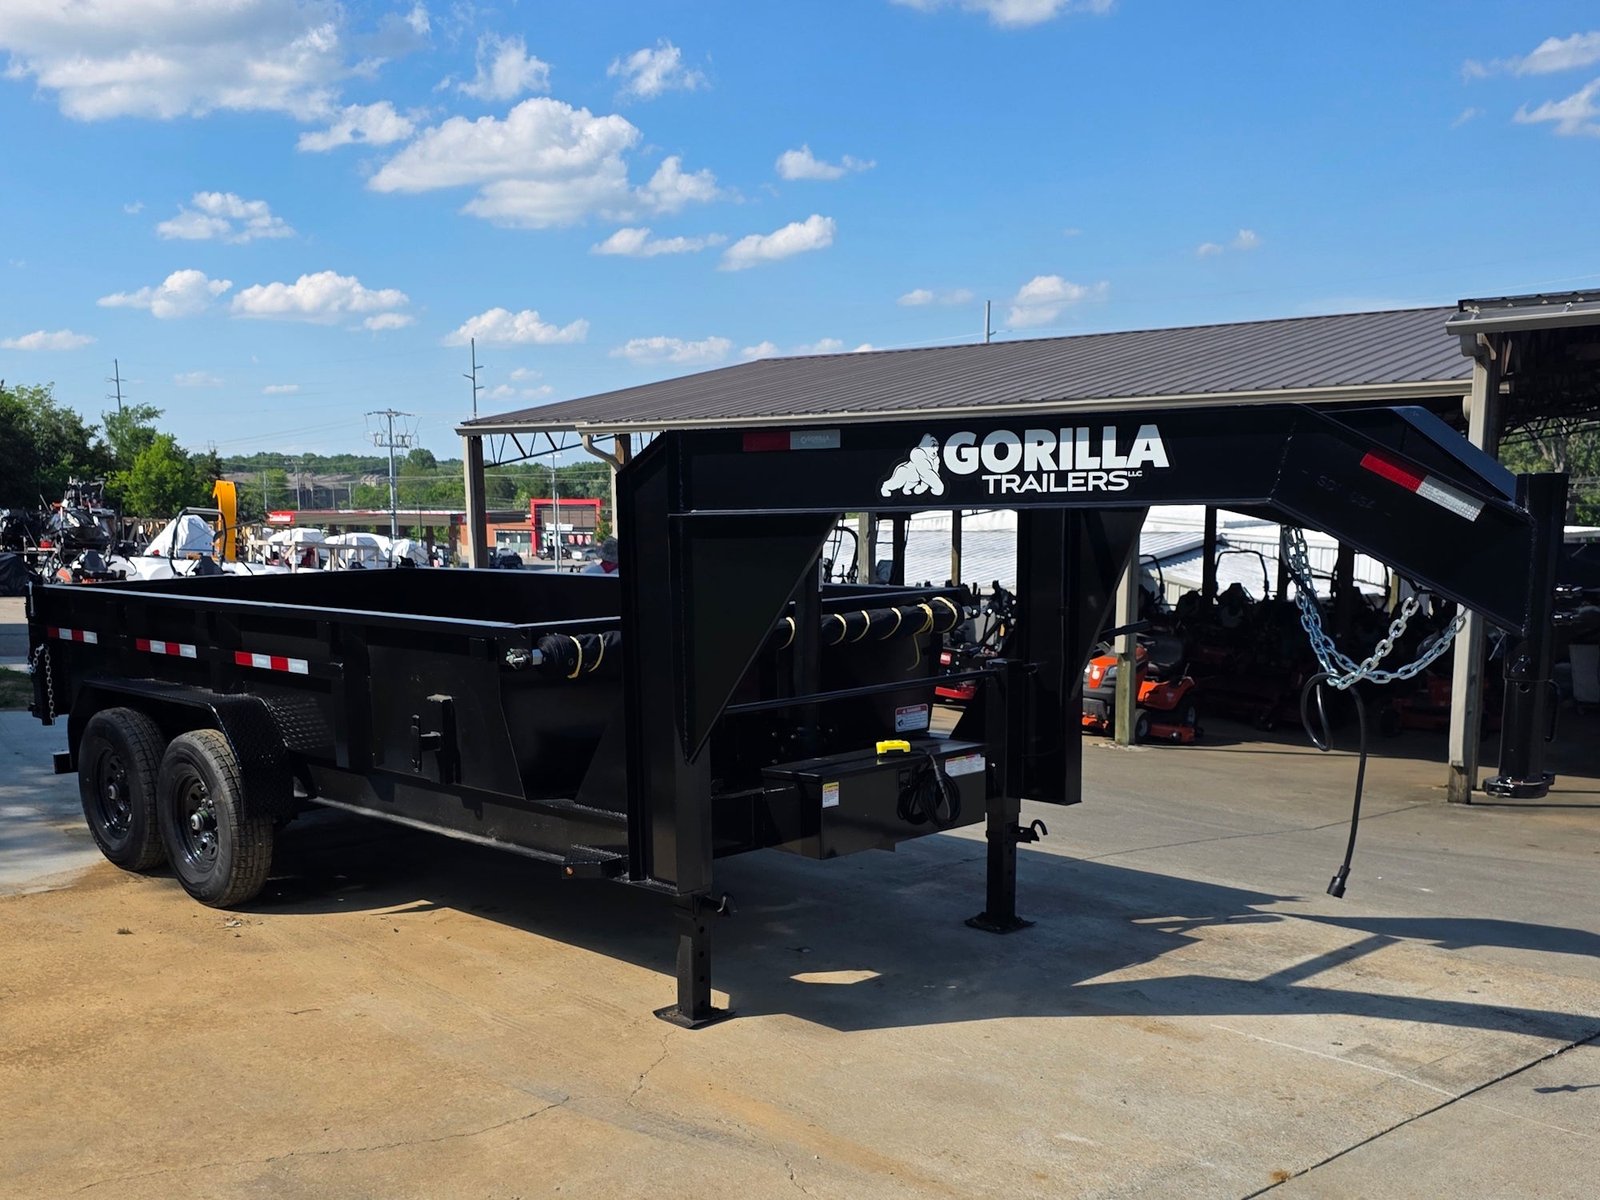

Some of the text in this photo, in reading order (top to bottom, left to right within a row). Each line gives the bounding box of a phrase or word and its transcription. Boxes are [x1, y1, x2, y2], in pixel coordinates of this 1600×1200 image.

[943, 424, 1170, 475] GORILLA
[981, 470, 1143, 494] TRAILERS LLC
